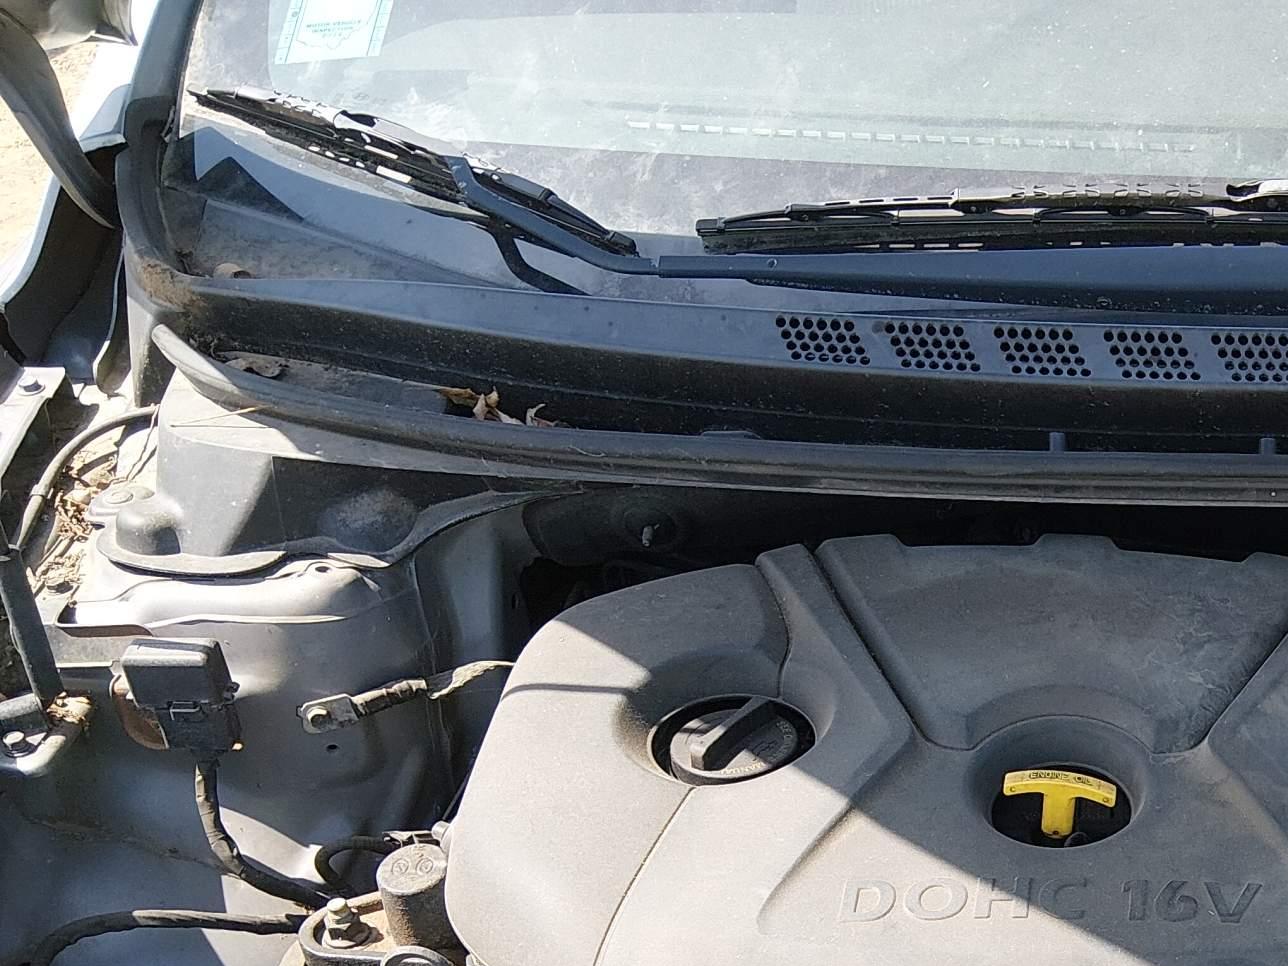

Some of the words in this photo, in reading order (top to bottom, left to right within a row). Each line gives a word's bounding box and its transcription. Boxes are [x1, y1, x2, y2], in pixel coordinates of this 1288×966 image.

[1029, 771, 1070, 780] ENGINE
[1073, 775, 1094, 787] OIL
[839, 875, 1089, 923] DOHC
[1119, 878, 1263, 924] 16V
